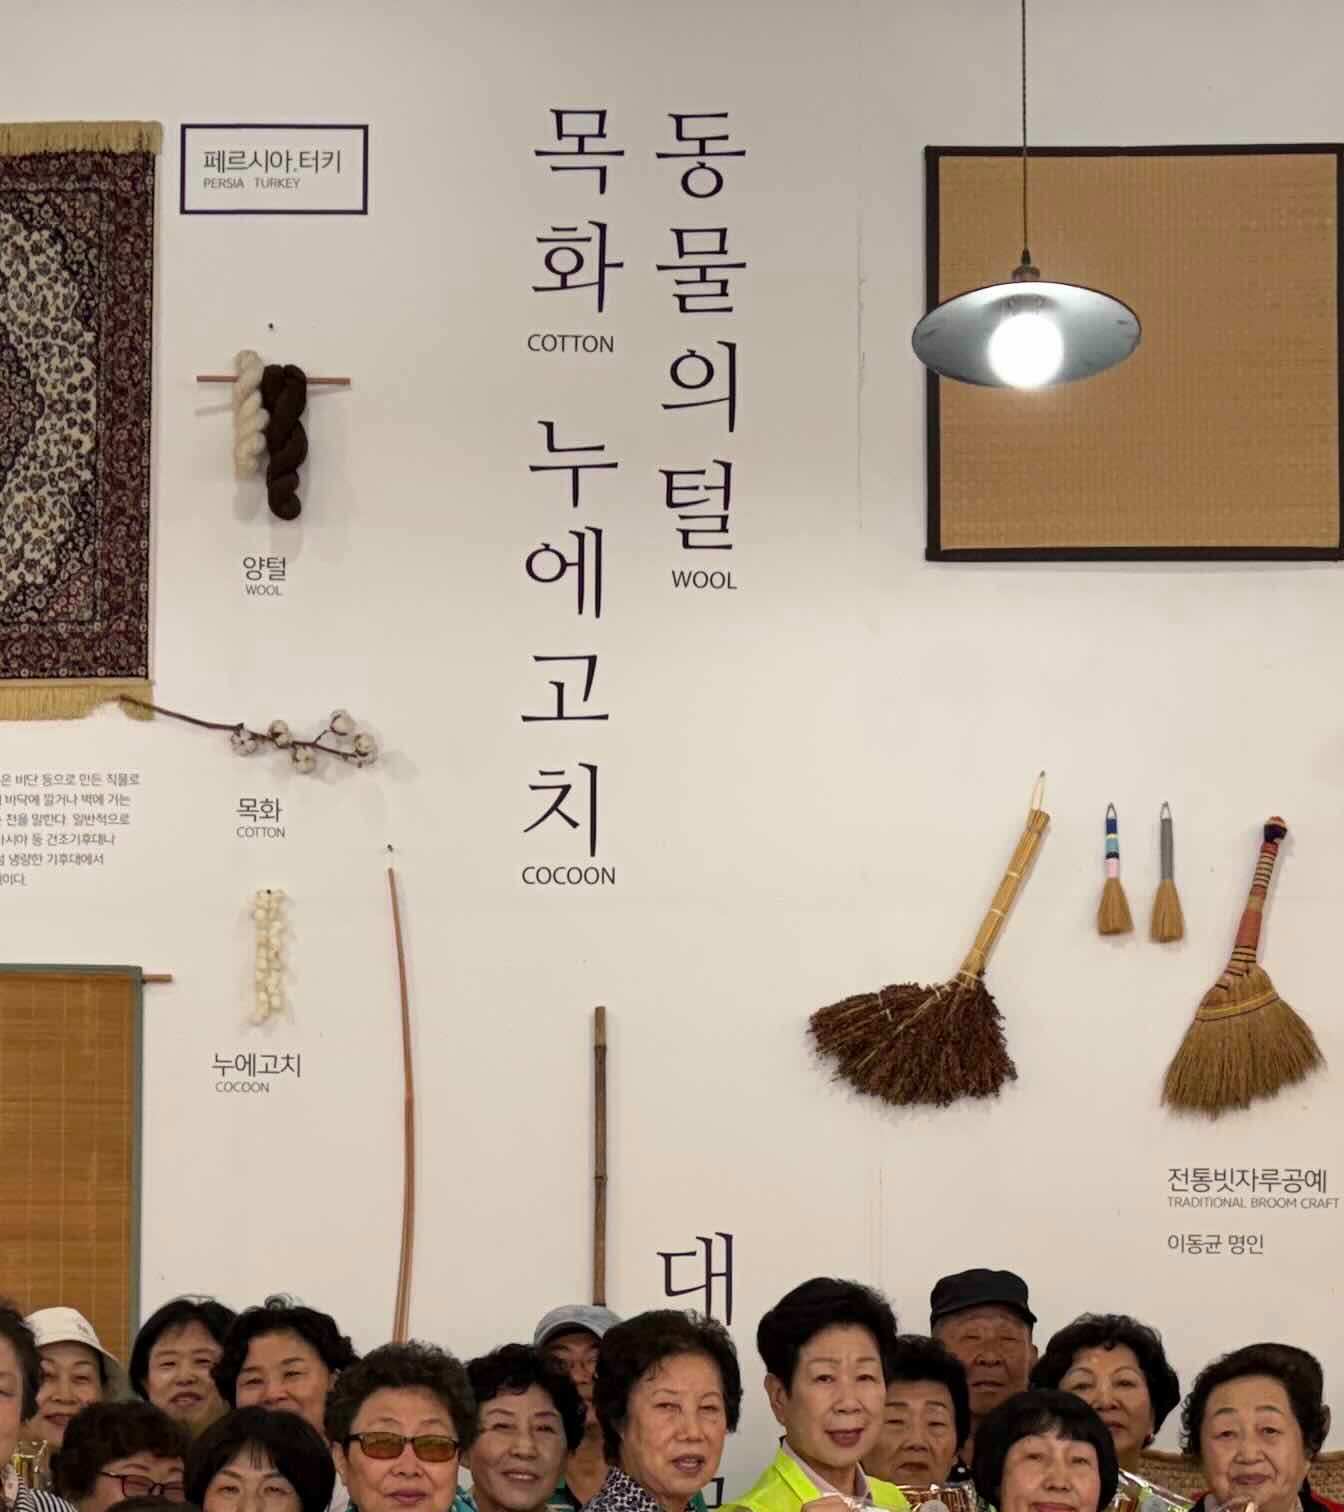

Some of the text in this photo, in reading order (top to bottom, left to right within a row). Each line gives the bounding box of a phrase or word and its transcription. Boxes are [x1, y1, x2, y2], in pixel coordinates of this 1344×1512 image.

[203, 177, 300, 189] PERSIA TURKEY
[532, 109, 624, 312] 목화
[528, 334, 613, 352] COTTON
[243, 557, 286, 581] 양털
[672, 570, 736, 589] WOOL
[246, 584, 282, 596] WOOL
[521, 421, 618, 857] 누에고치
[237, 798, 282, 823] 목화
[236, 826, 285, 838] COTTON
[522, 866, 615, 885] COCOON
[212, 1053, 300, 1078] 누에고치
[216, 1080, 269, 1093] COCOON
[1168, 1168, 1326, 1193] 전통빗자루공예
[1168, 1196, 1339, 1209] TRADITIONAL BROOM CRAFT
[1168, 1234, 1263, 1255] 이동균 명인
